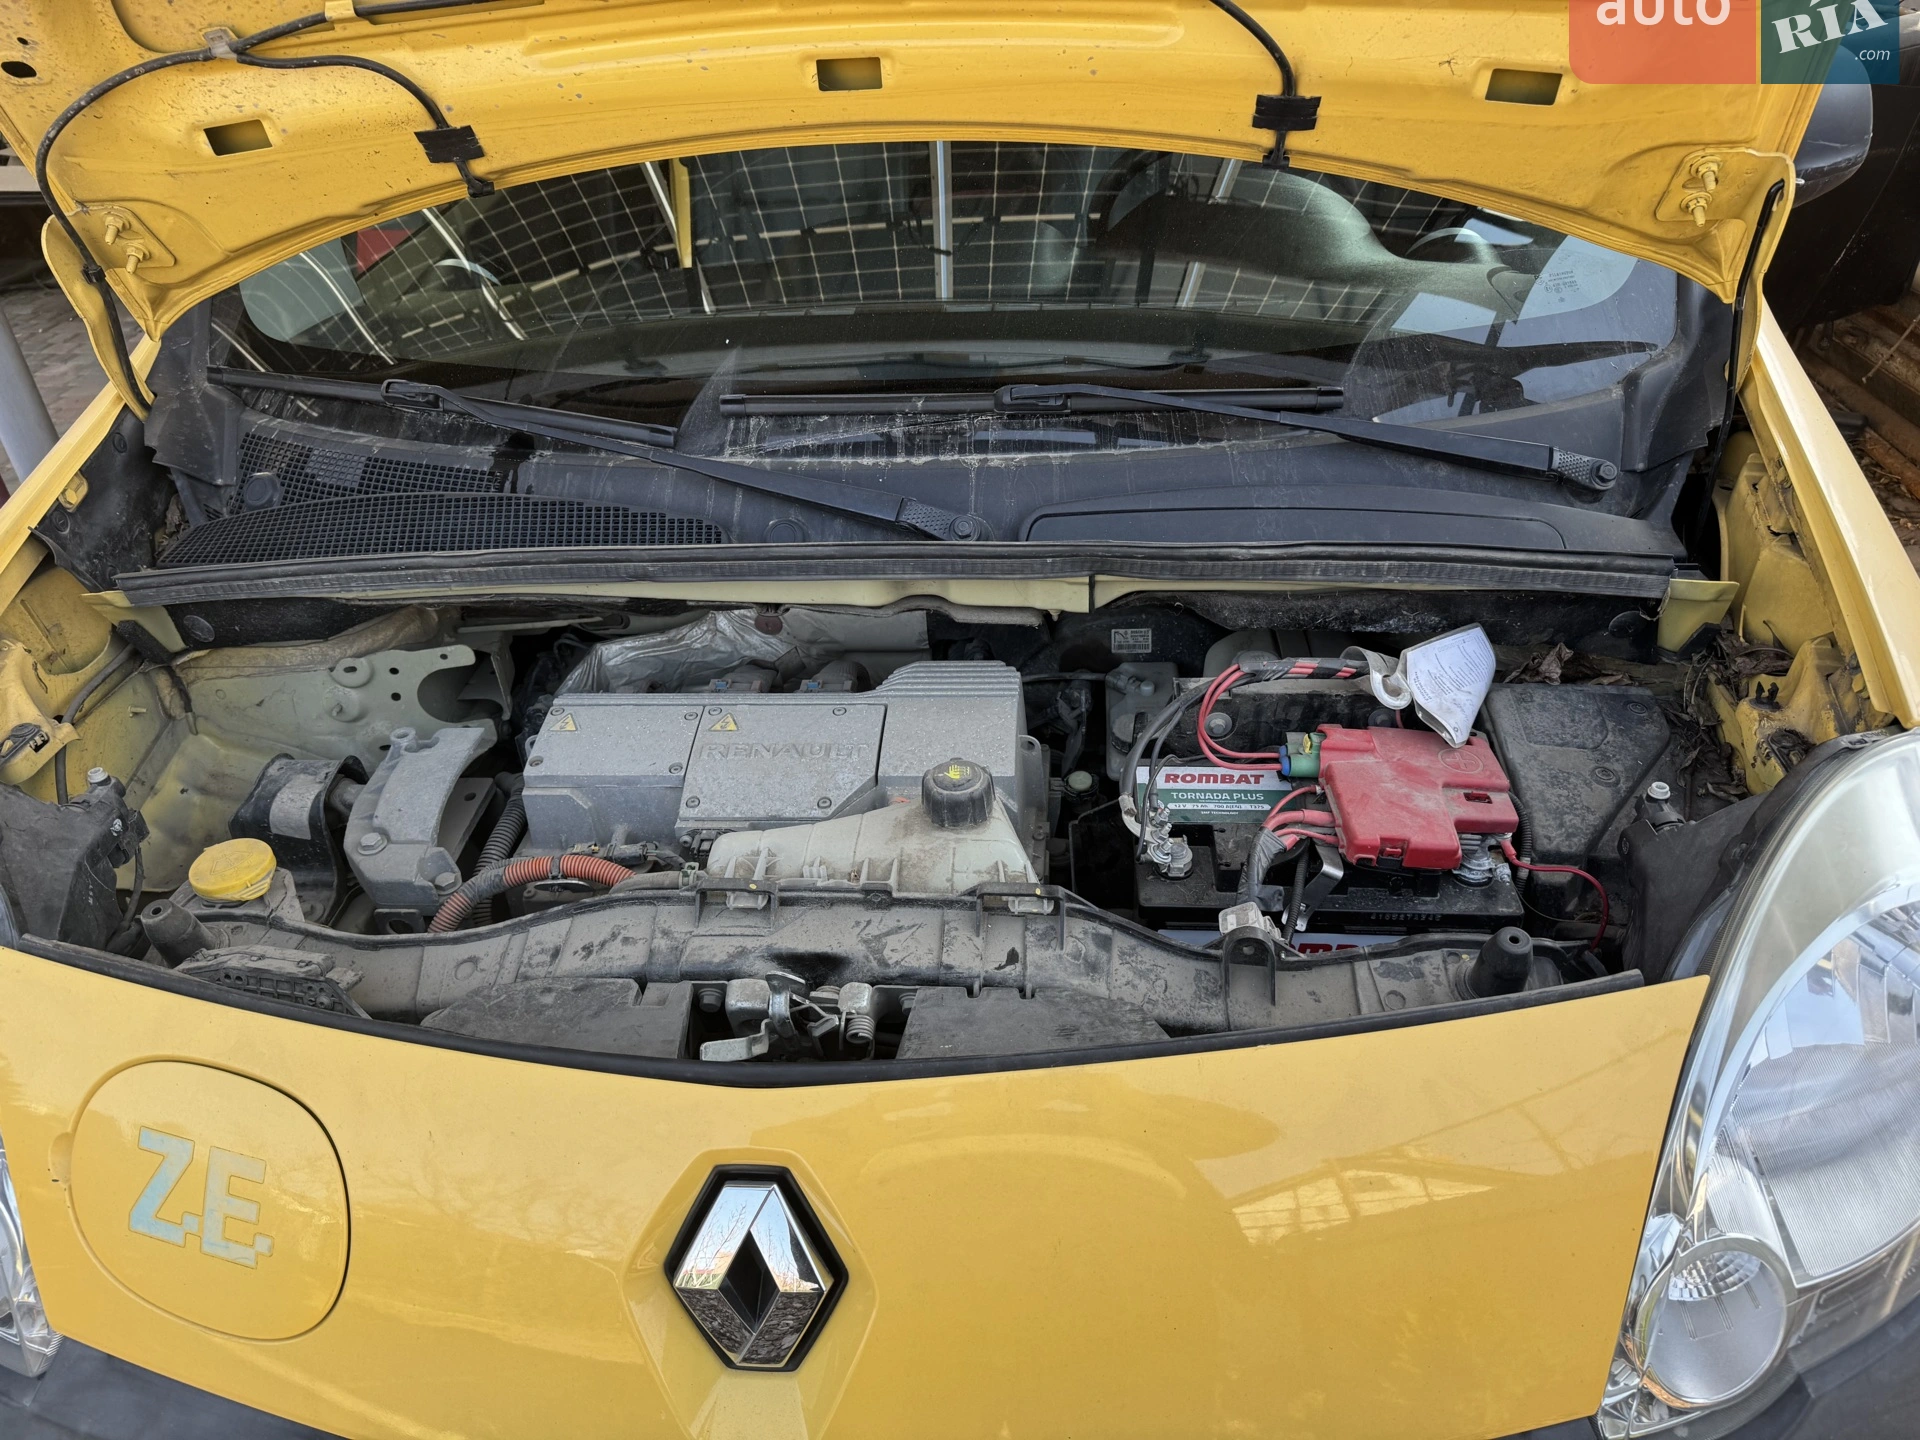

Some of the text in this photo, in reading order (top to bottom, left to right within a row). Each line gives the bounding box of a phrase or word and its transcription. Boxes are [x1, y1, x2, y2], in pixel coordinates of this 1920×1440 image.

[700, 742, 869, 759] RENAULT
[1164, 773, 1265, 785] ROMBAT
[1171, 791, 1264, 801] TORNADA PLUS
